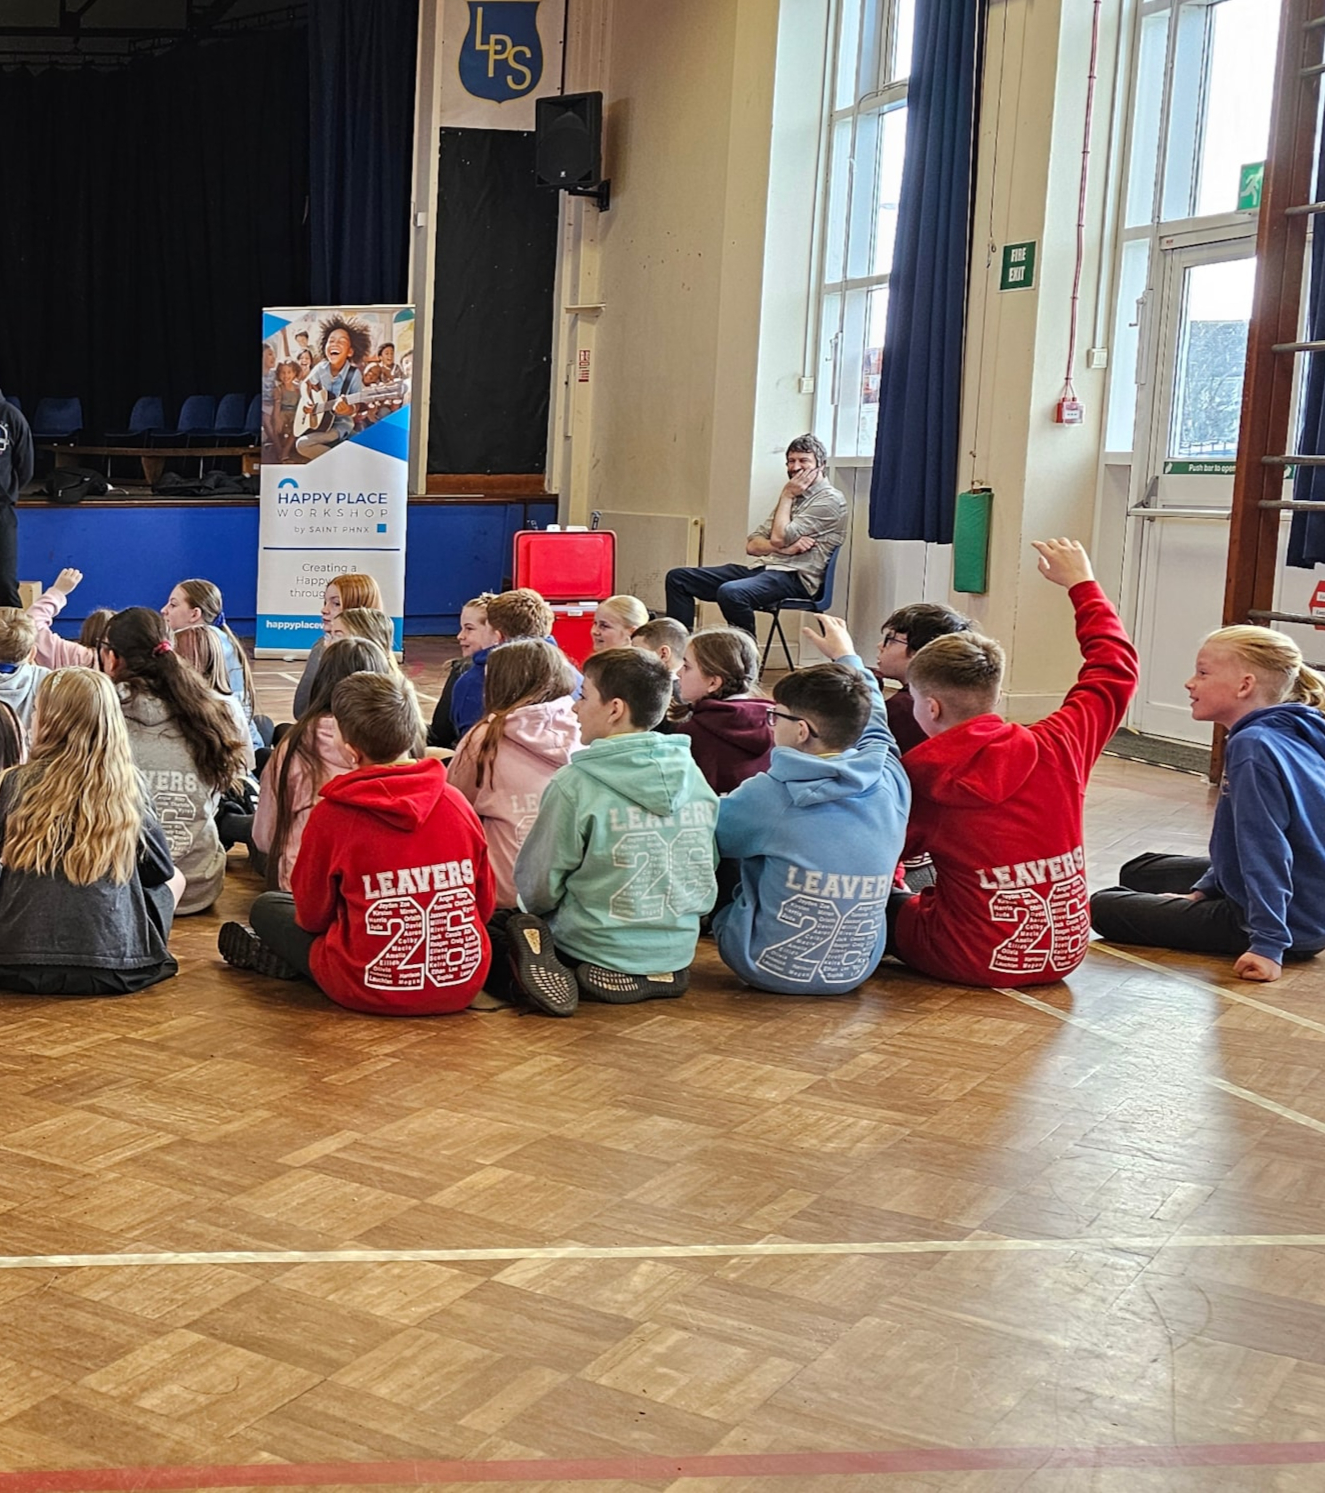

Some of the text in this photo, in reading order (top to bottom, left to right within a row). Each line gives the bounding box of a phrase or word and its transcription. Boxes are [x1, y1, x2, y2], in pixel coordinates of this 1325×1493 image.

[475, 7, 532, 90] LPS
[1010, 247, 1027, 263] FIRE
[1008, 266, 1026, 282] EXIT
[1188, 464, 1203, 472] Push
[1204, 464, 1214, 472] bar
[1214, 464, 1221, 472] to
[277, 492, 388, 504] HAPPY PLACE
[277, 508, 389, 518] WORKSHOP
[294, 526, 370, 535] by SAINT PHNX
[302, 563, 348, 575] Creating
[296, 576, 331, 587] Happy
[290, 588, 327, 600] throug
[974, 845, 1085, 890] LEAVERS
[361, 858, 475, 900] LEAVERS
[785, 865, 888, 900] LEAVER
[988, 874, 1090, 973] 26
[364, 887, 482, 990] 26
